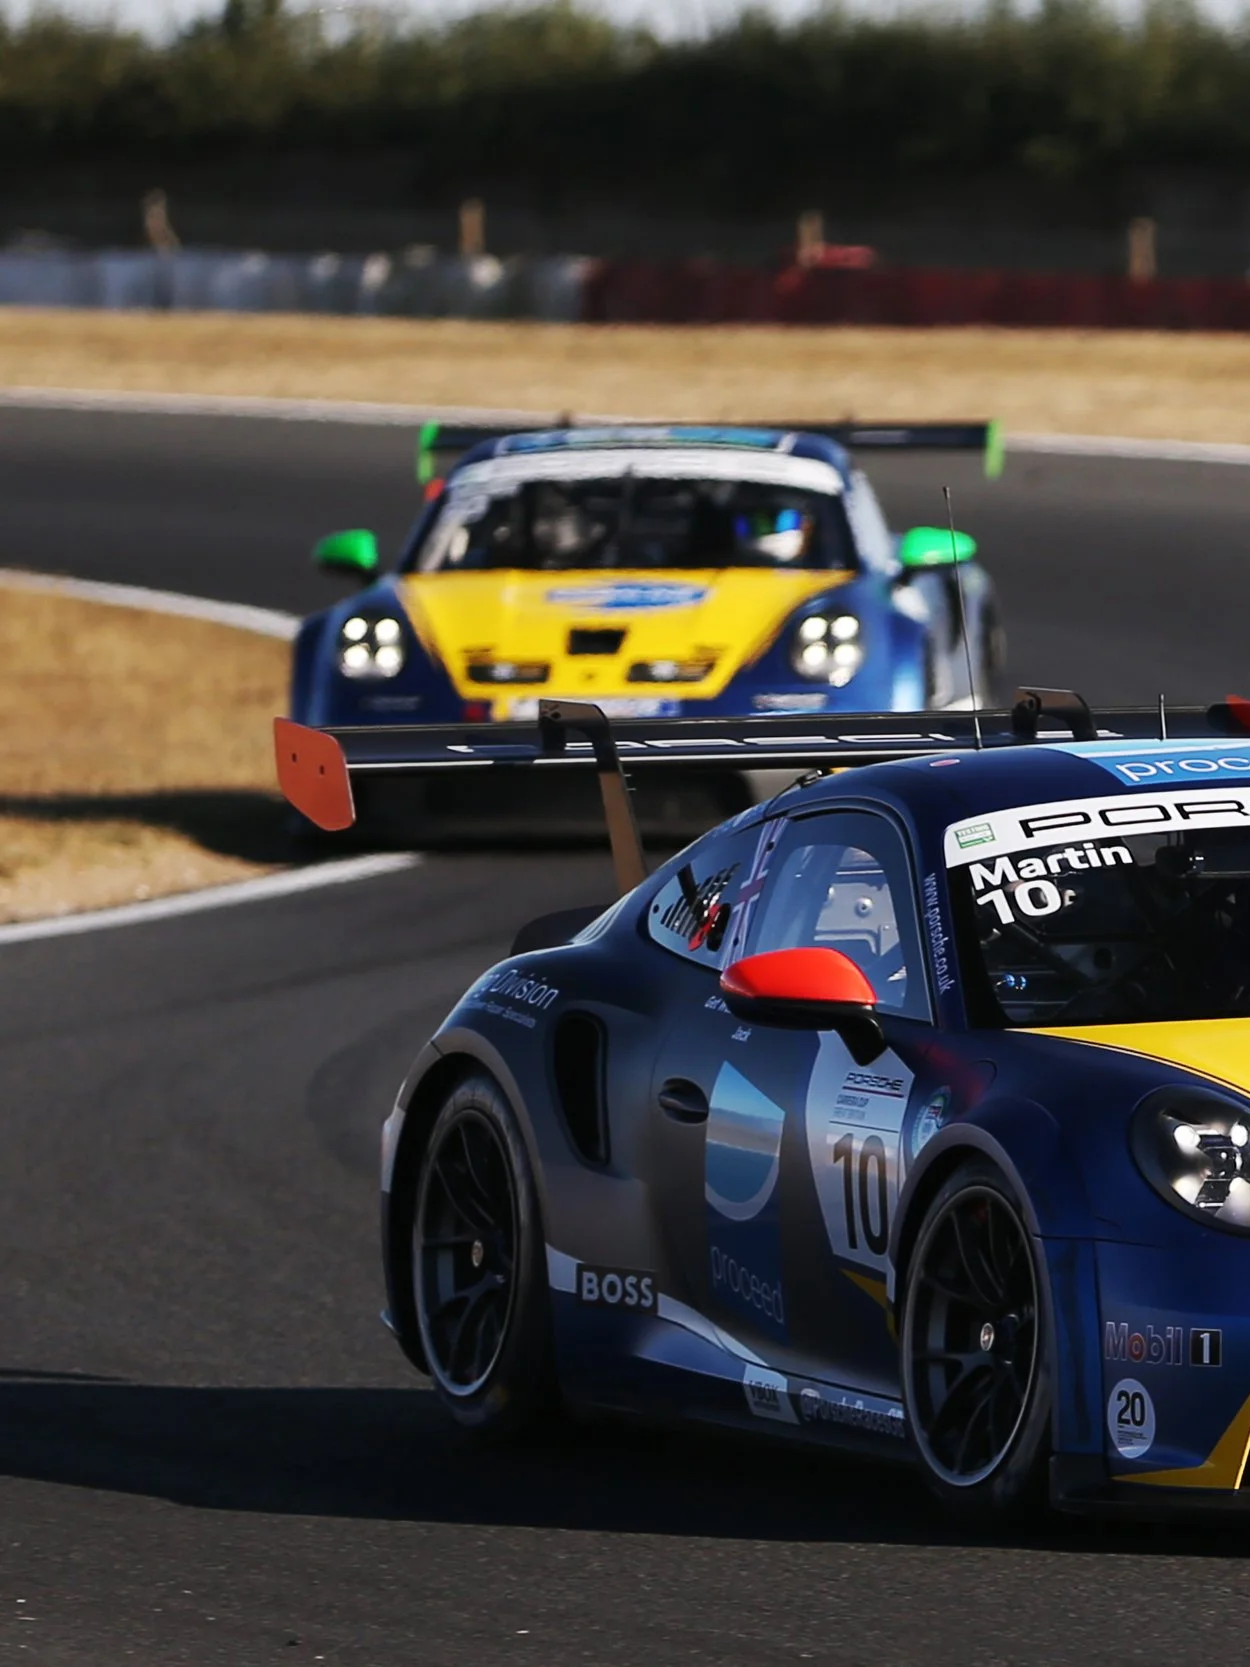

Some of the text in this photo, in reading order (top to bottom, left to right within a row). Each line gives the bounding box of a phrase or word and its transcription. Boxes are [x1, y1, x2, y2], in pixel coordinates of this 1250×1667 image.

[969, 842, 1133, 891] Martin
[976, 879, 1062, 925] 10
[923, 872, 955, 995] www.porsche.co.uk
[490, 969, 560, 1010] Division
[846, 1072, 904, 1091] PORSCHE
[833, 1133, 889, 1255] 10
[581, 1271, 654, 1308] BOSS
[710, 1245, 785, 1325] proceed
[1105, 1321, 1183, 1365] Mobil
[1117, 1390, 1146, 1427] 20
